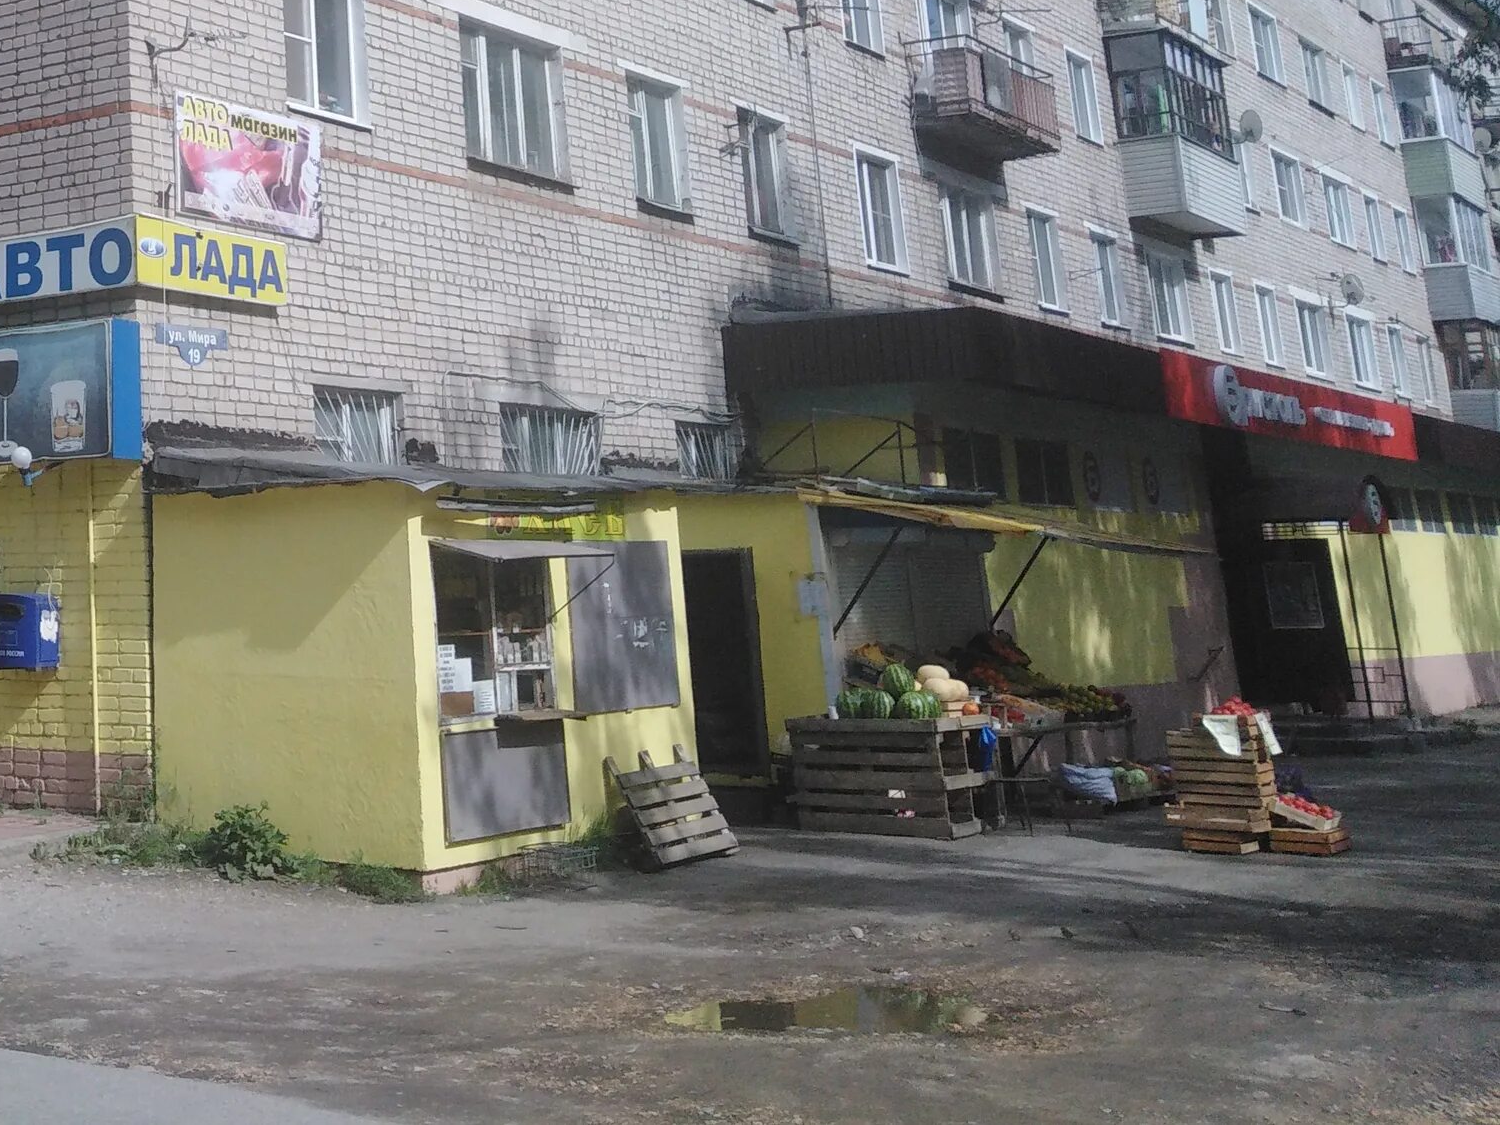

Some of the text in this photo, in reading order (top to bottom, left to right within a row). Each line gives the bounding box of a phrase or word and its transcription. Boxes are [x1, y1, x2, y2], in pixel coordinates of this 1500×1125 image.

[181, 119, 233, 151] ЛАДА
[182, 95, 297, 143] АВТО магазин
[170, 232, 284, 298] ЛАДА
[168, 330, 217, 348] ул. Мира
[188, 348, 201, 364] 19
